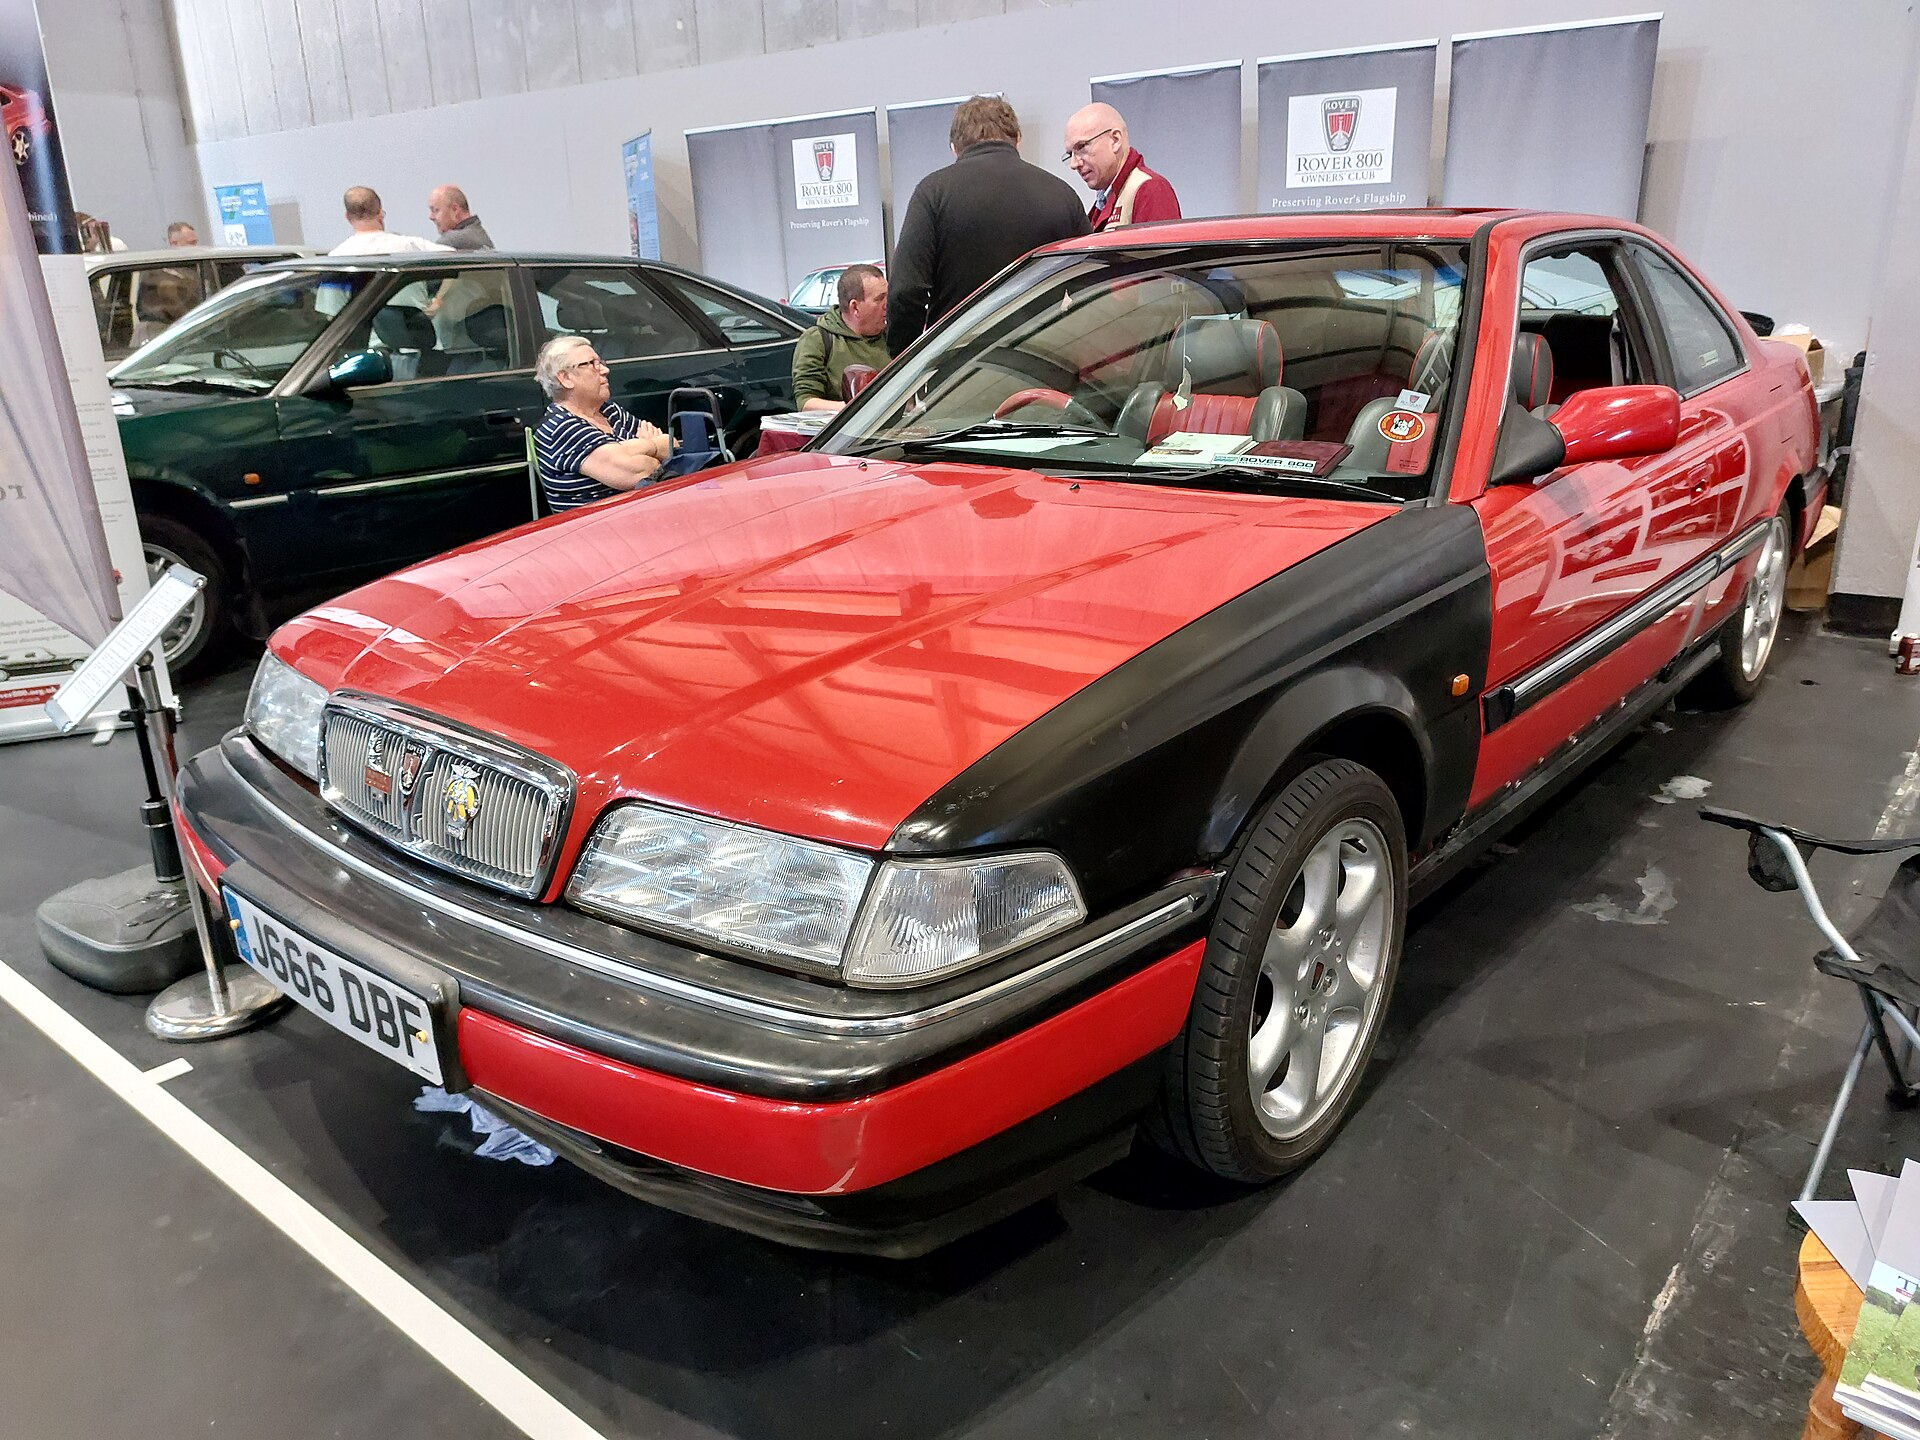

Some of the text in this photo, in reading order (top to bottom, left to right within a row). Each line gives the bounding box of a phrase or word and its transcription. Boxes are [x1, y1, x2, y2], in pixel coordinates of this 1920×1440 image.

[1325, 100, 1358, 110] ROVER
[1297, 152, 1382, 172] ROVER 800
[1348, 171, 1375, 180] CLUB
[802, 182, 852, 197] ROVER 800
[1272, 192, 1406, 208] Preserving Rover's Flagship
[790, 220, 820, 229] Preserving
[844, 217, 869, 226] Flagship
[1240, 457, 1283, 465] ROVER
[253, 915, 422, 1059] J666 DBF
